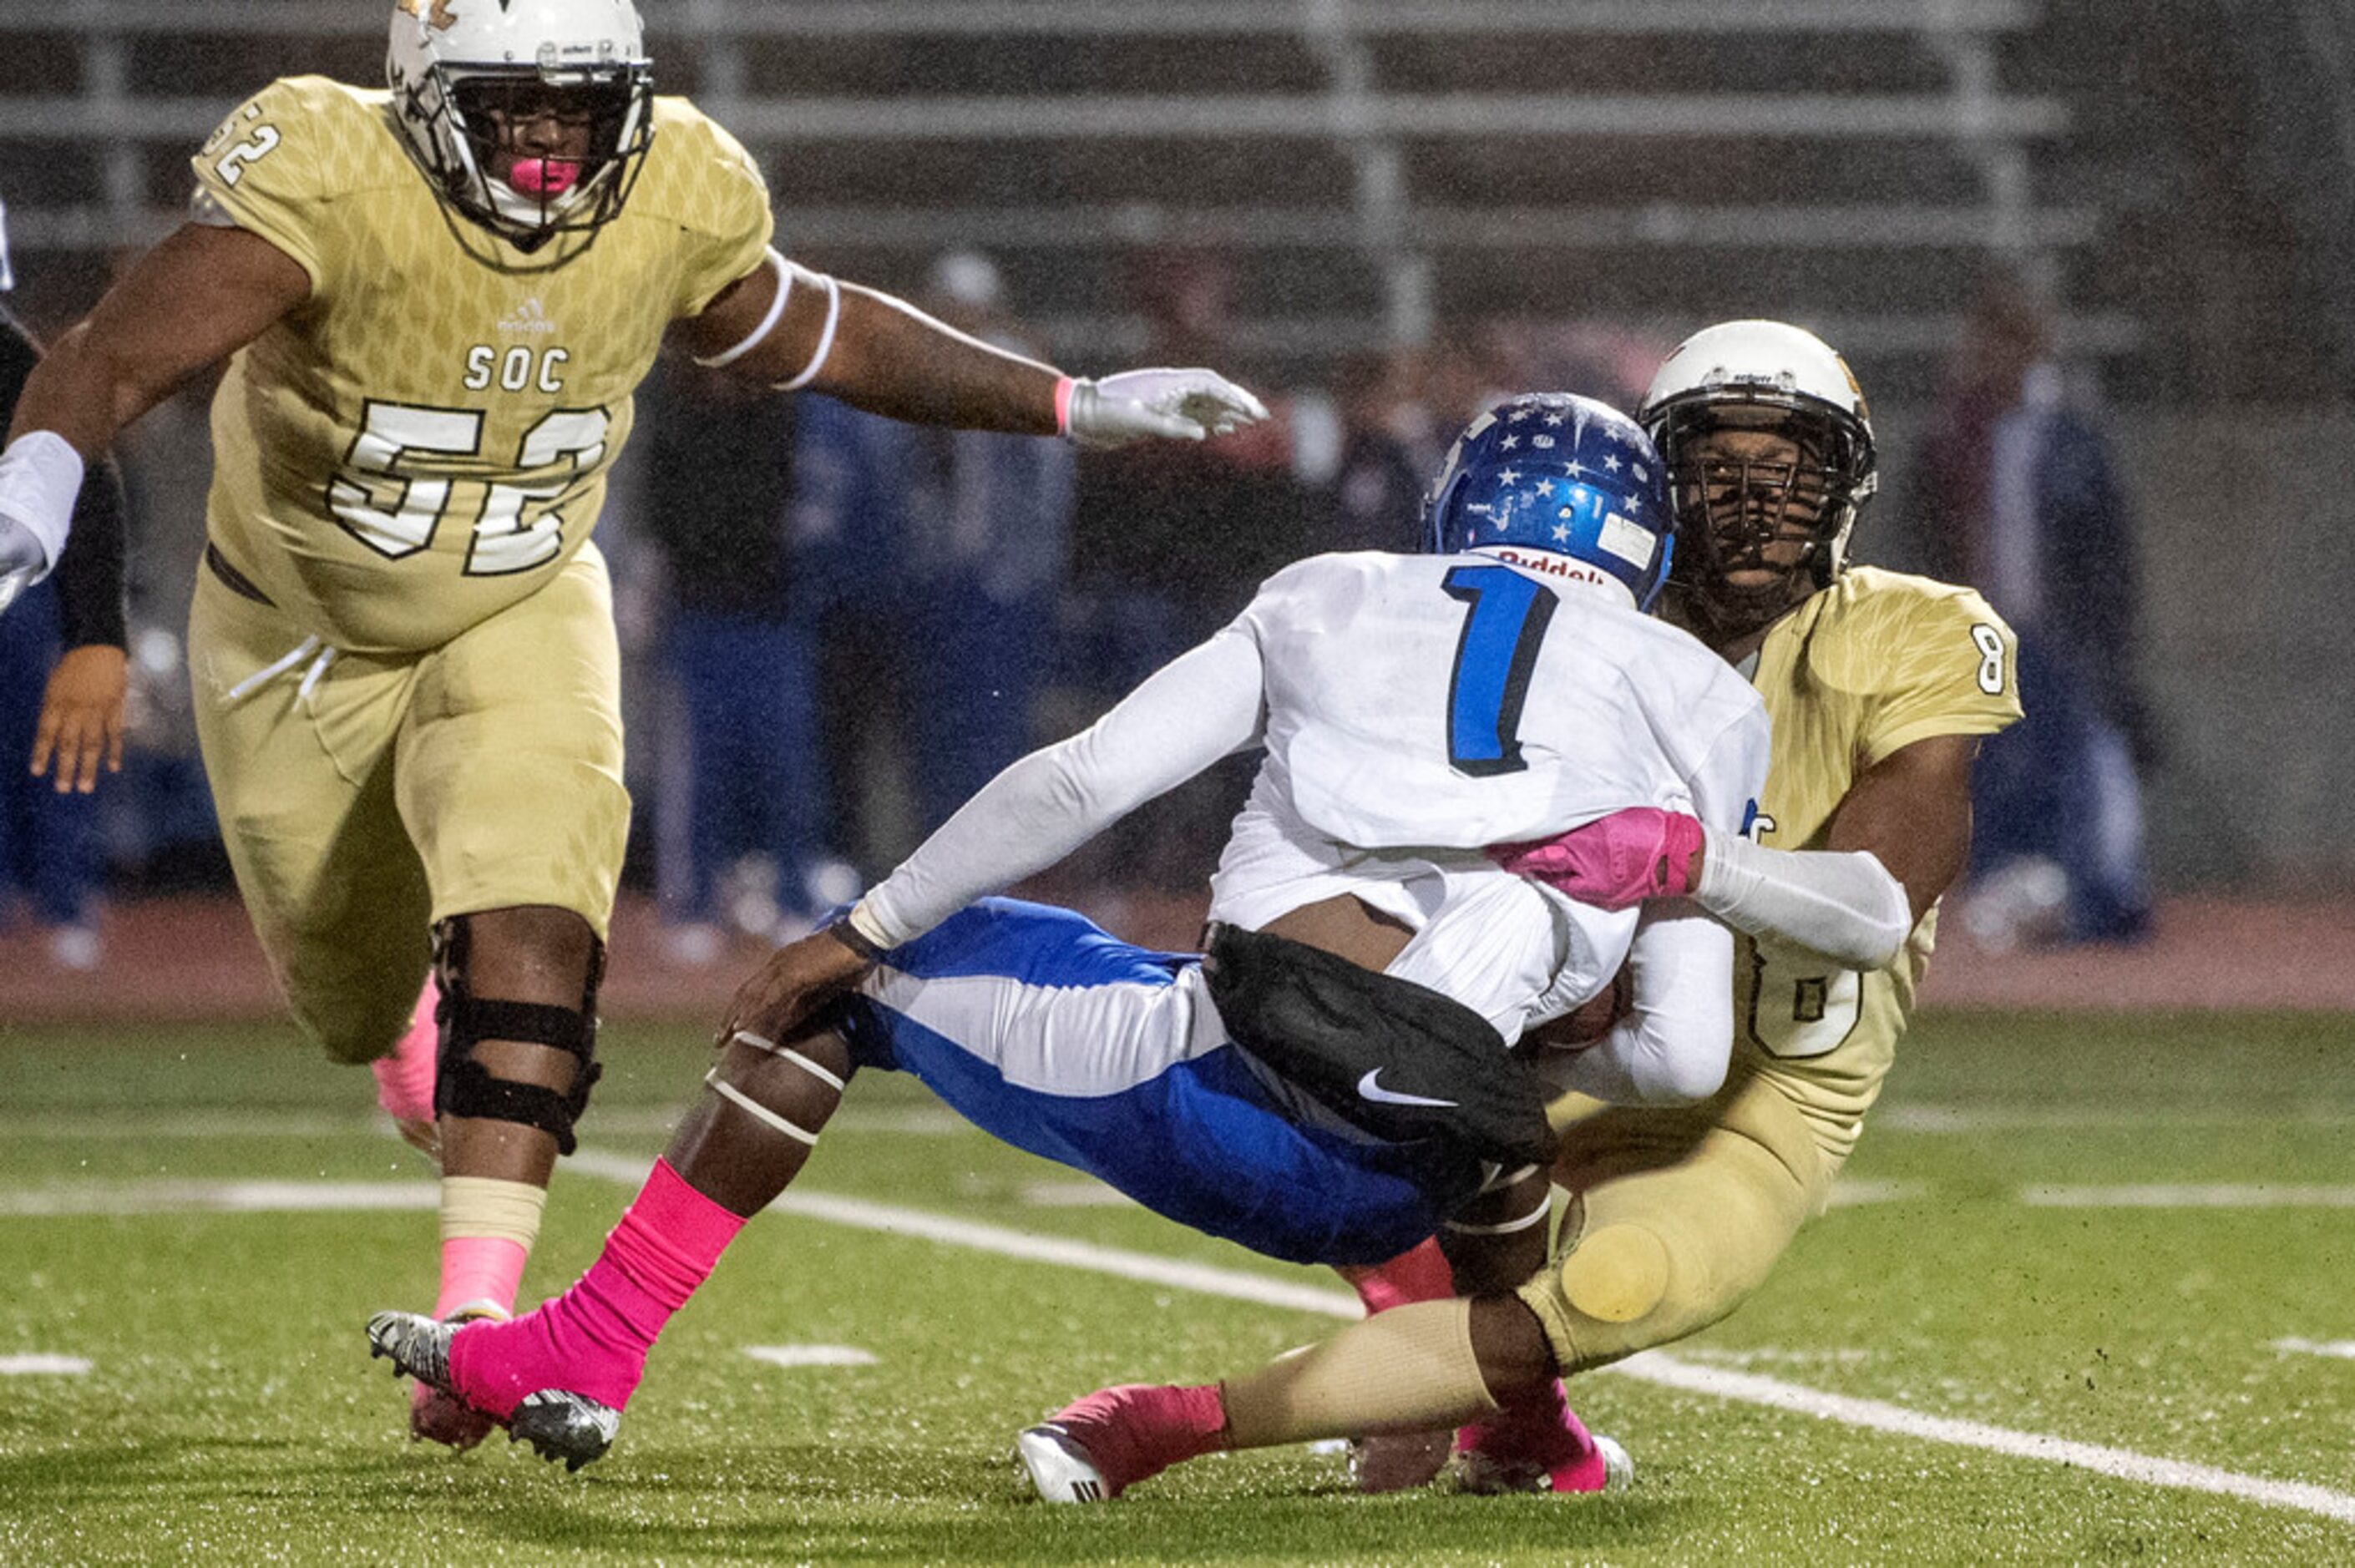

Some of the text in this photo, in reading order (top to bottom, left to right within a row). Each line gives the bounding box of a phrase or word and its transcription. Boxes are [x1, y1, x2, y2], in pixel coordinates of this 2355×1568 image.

[463, 343, 569, 393] SOC
[326, 397, 612, 576] 52
[1440, 565, 1561, 778] 1
[1969, 623, 2006, 696] 8
